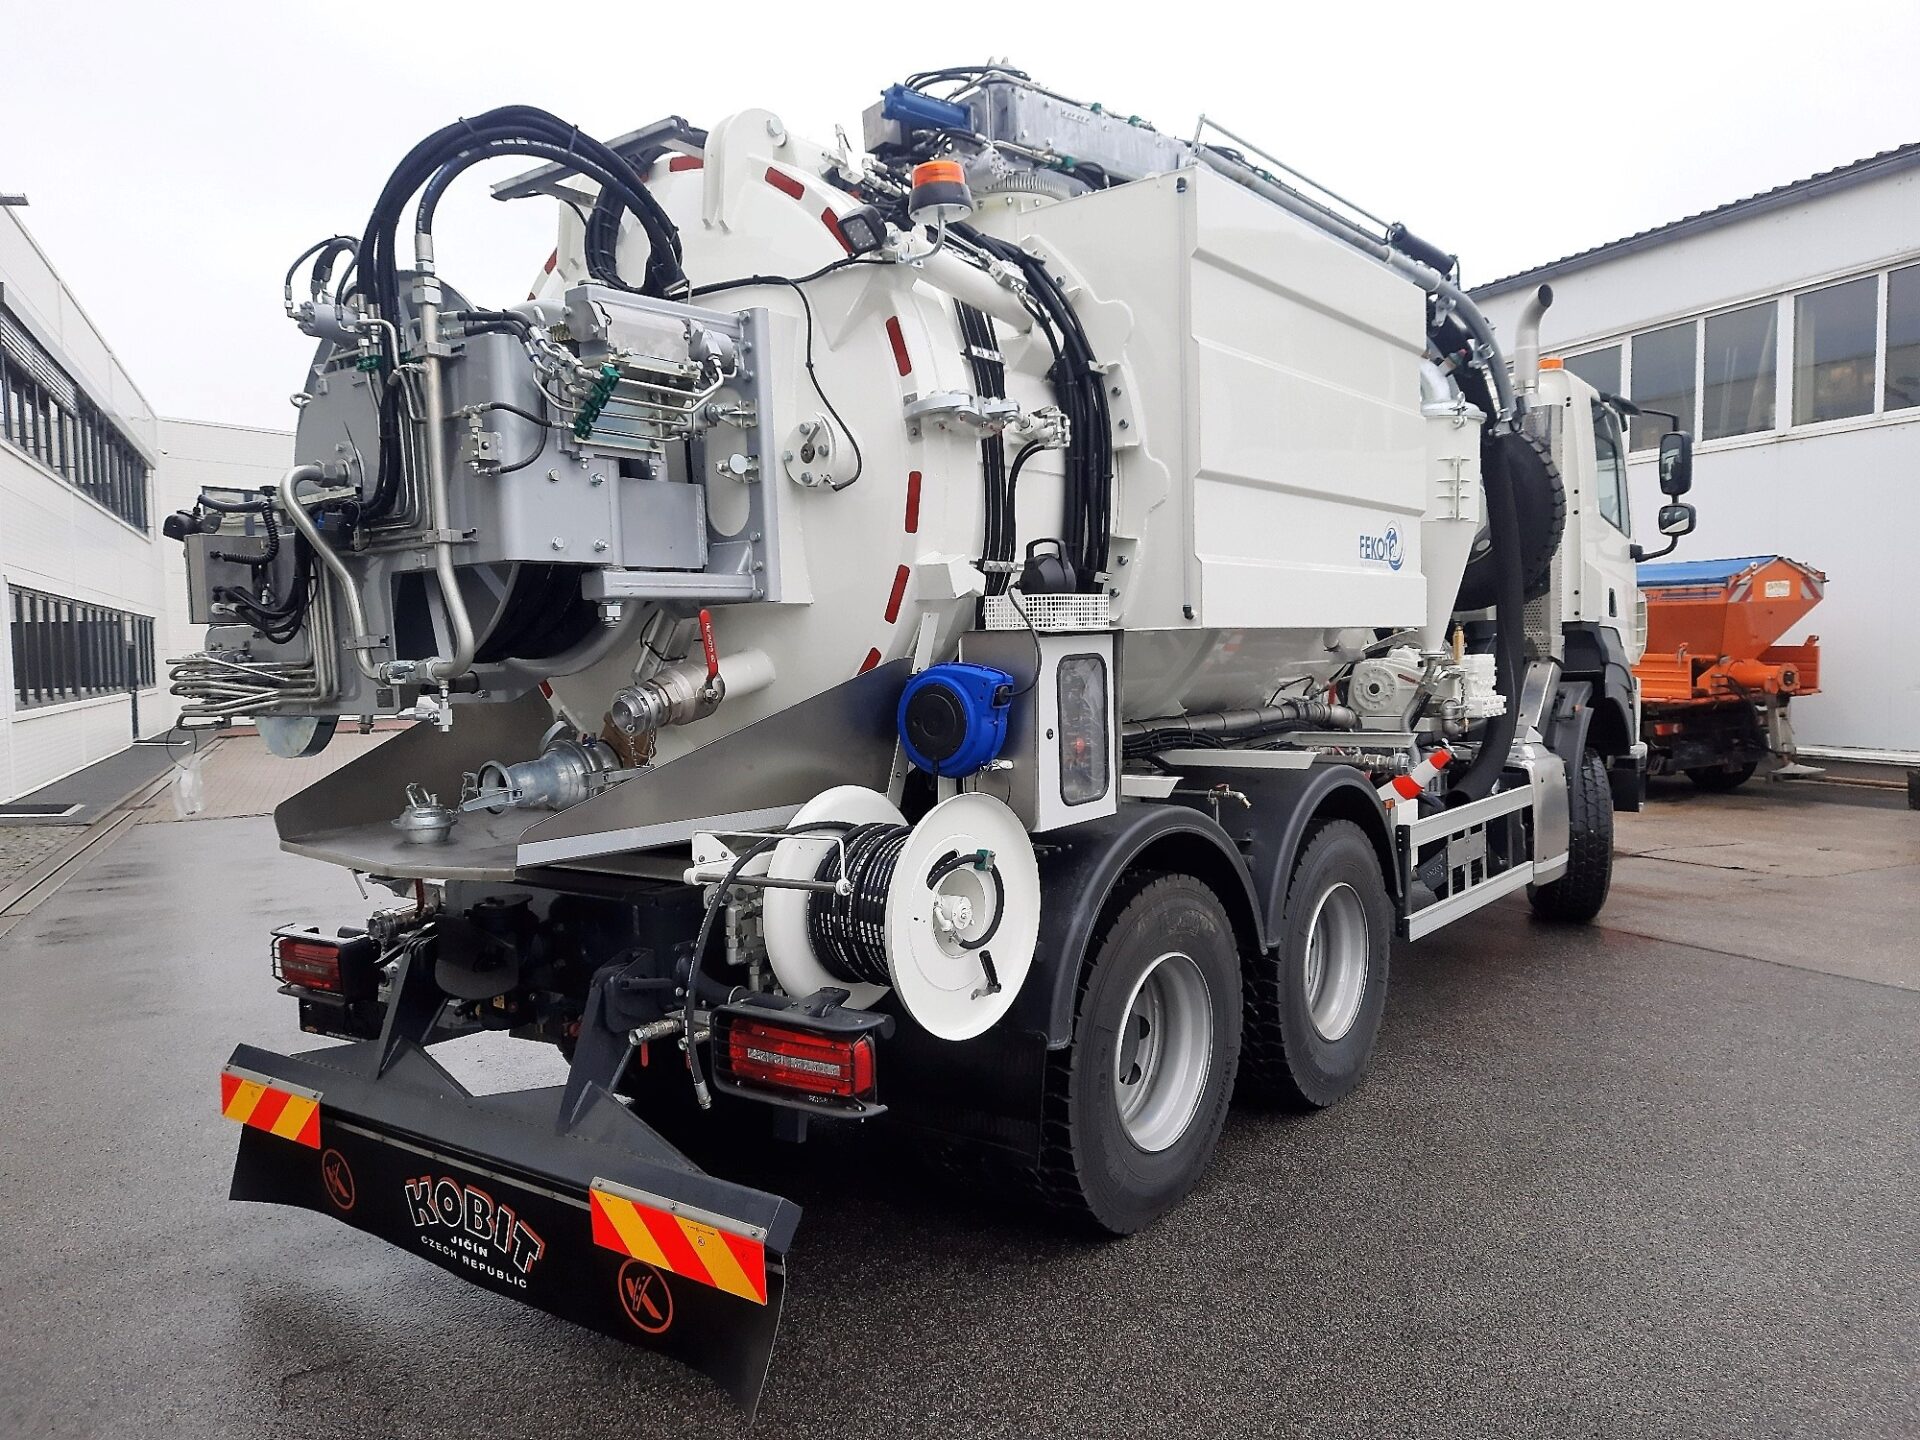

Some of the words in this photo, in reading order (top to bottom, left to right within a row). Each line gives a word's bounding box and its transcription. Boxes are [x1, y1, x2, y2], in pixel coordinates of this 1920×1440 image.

[404, 1176, 546, 1273] KOBIT
[450, 1235, 488, 1258] JIČÍN
[420, 1235, 458, 1260] CZECH
[462, 1255, 528, 1289] REPUBLIC
